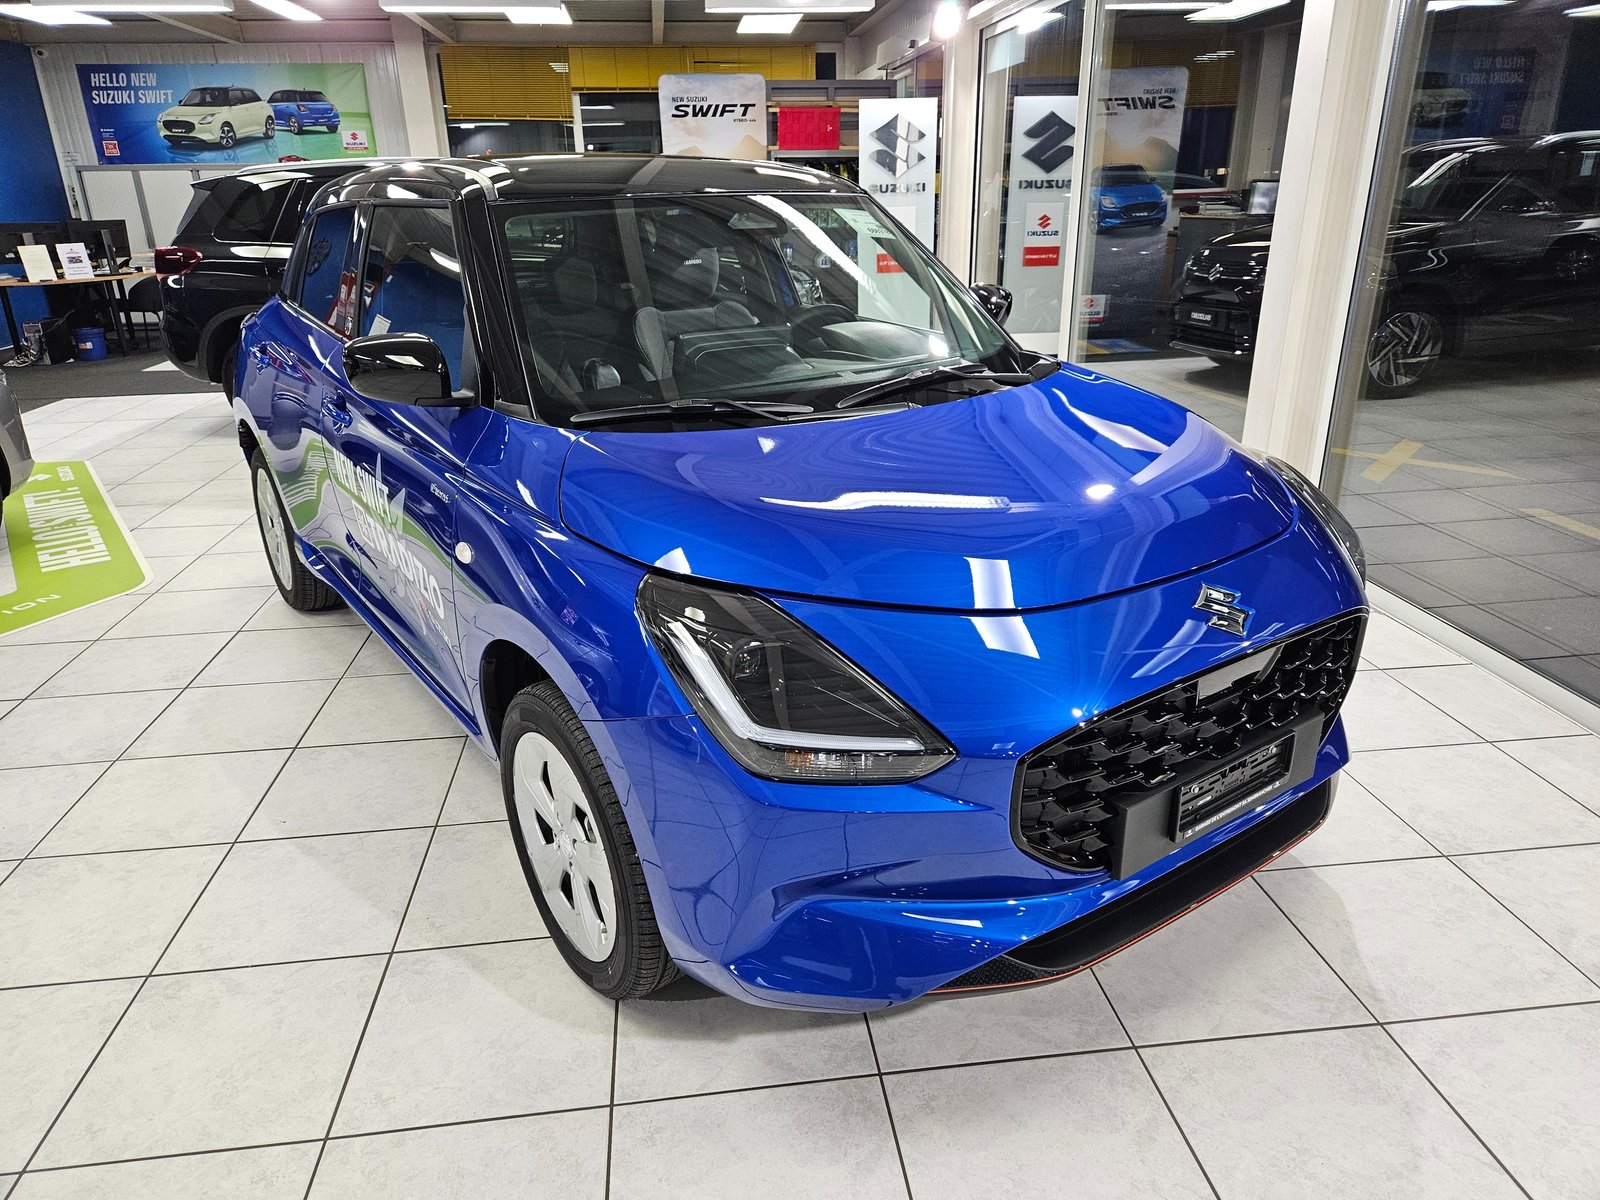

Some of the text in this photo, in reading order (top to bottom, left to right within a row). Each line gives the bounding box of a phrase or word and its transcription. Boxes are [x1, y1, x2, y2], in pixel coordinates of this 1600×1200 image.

[91, 73, 157, 87] HELLO NEW
[92, 90, 173, 104] SUZUKI SWIFT
[671, 103, 756, 118] SWIFT
[868, 182, 926, 194] SUZUKI
[333, 448, 358, 496] NEW
[356, 465, 392, 524] SWIFT
[32, 525, 111, 573] HELLO
